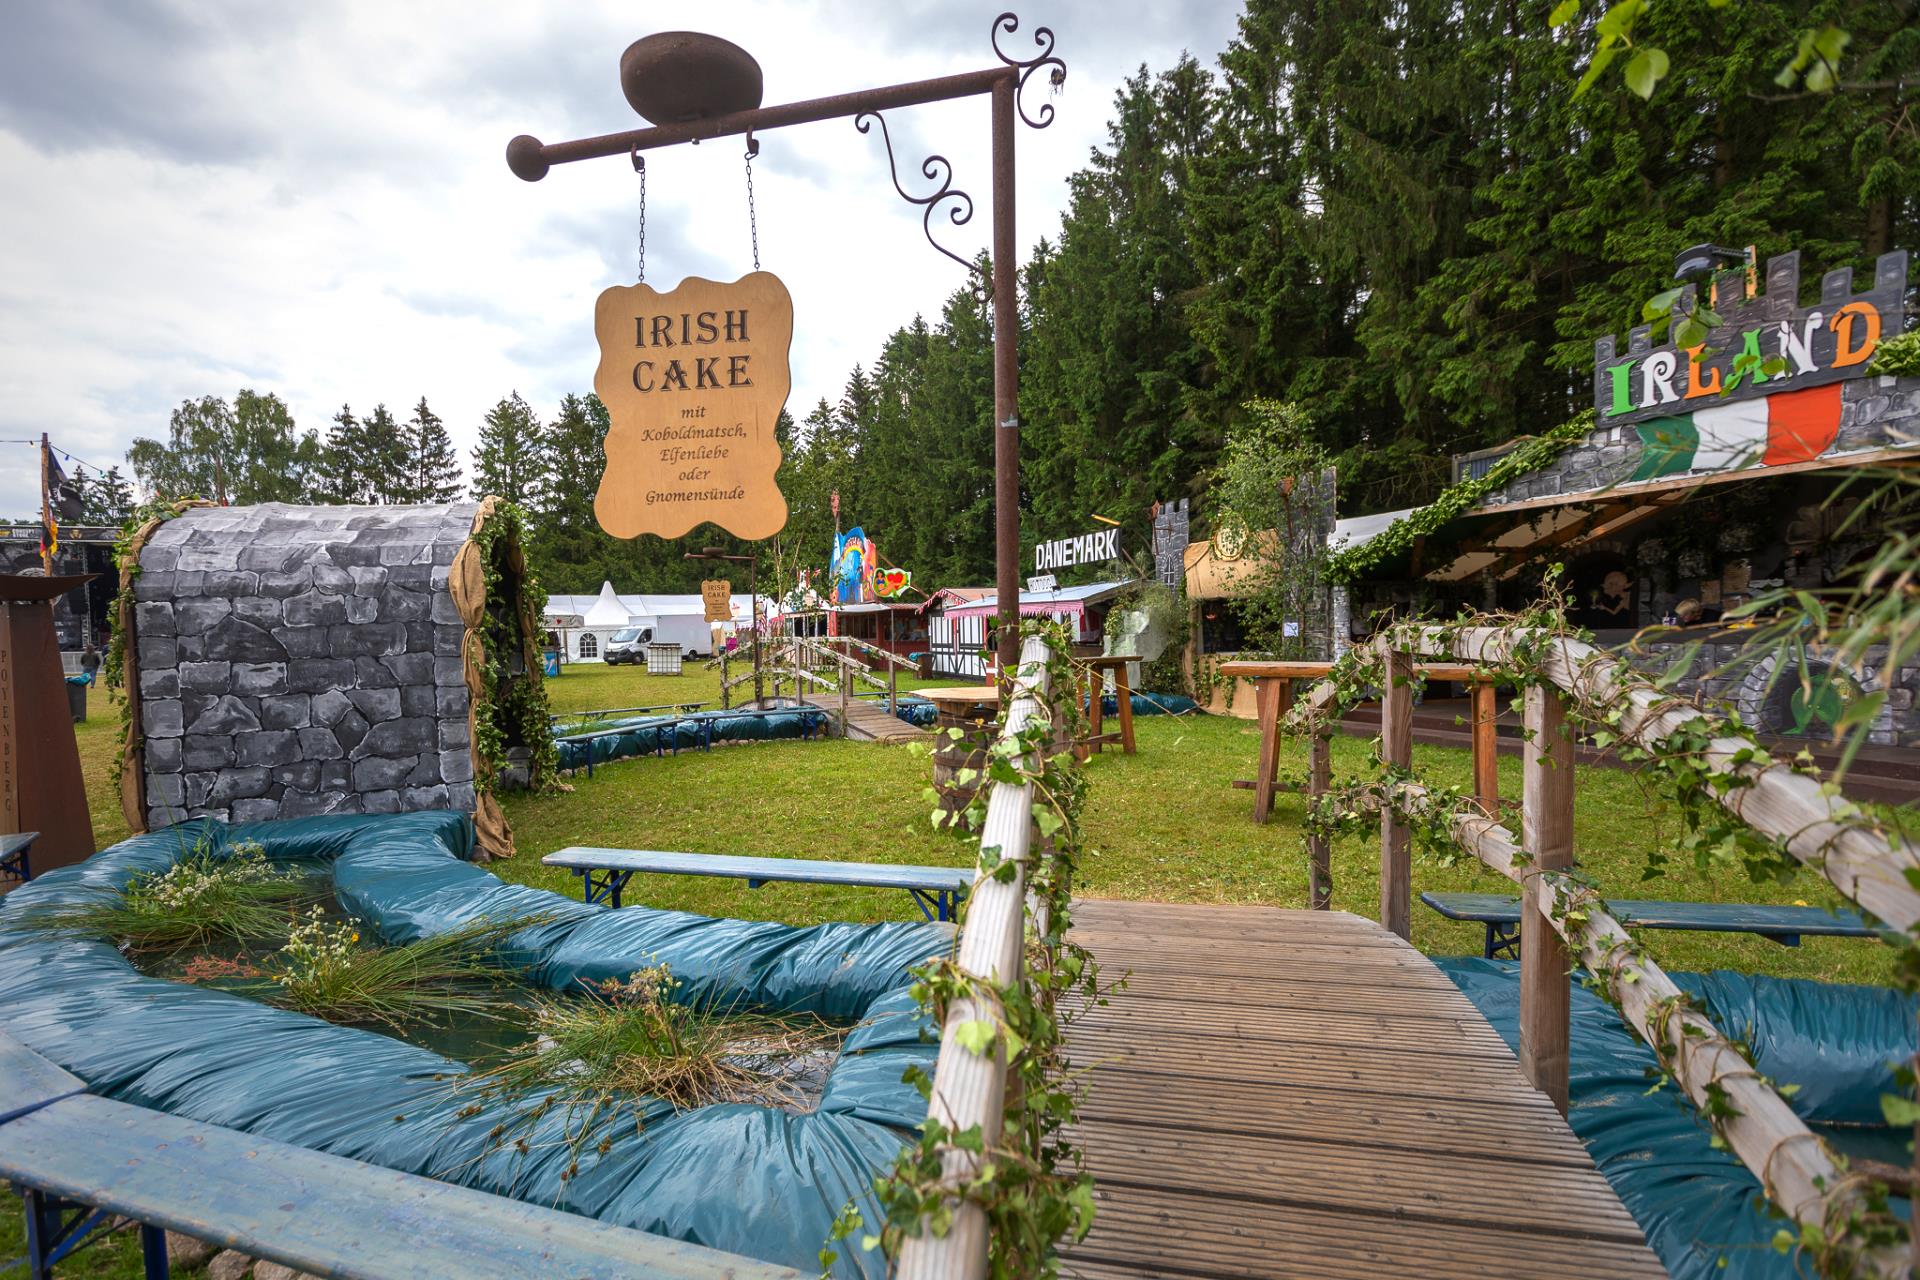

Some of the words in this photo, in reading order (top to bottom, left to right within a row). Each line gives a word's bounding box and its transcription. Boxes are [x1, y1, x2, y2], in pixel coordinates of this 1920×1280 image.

[633, 309, 751, 349] IRISH
[1605, 301, 1882, 417] IRLAND
[633, 355, 754, 393] CAKE
[680, 405, 707, 419] mit
[640, 422, 748, 442] Koboldmatsch,
[659, 446, 729, 465] Elfenliebe
[678, 468, 711, 481] oder
[645, 488, 745, 506] Gnomensünde
[1036, 529, 1117, 570] DÄNEMARK
